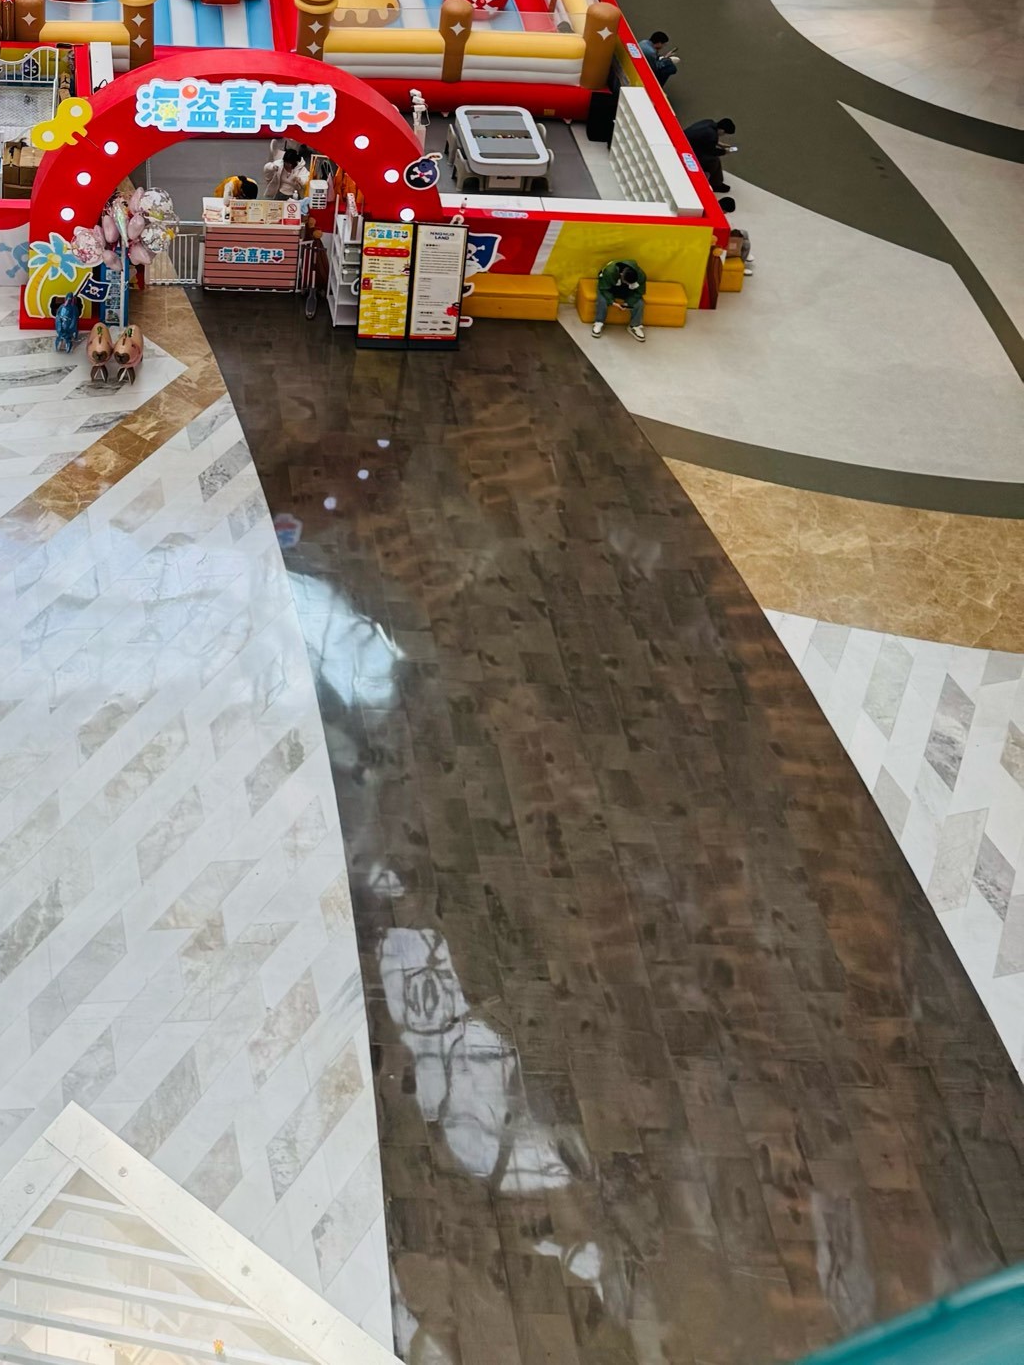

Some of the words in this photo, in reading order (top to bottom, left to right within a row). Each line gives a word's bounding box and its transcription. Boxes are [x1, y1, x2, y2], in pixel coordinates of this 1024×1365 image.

[141, 84, 331, 129] 海盗嘉年华
[219, 247, 283, 262] 海盗嘉年华
